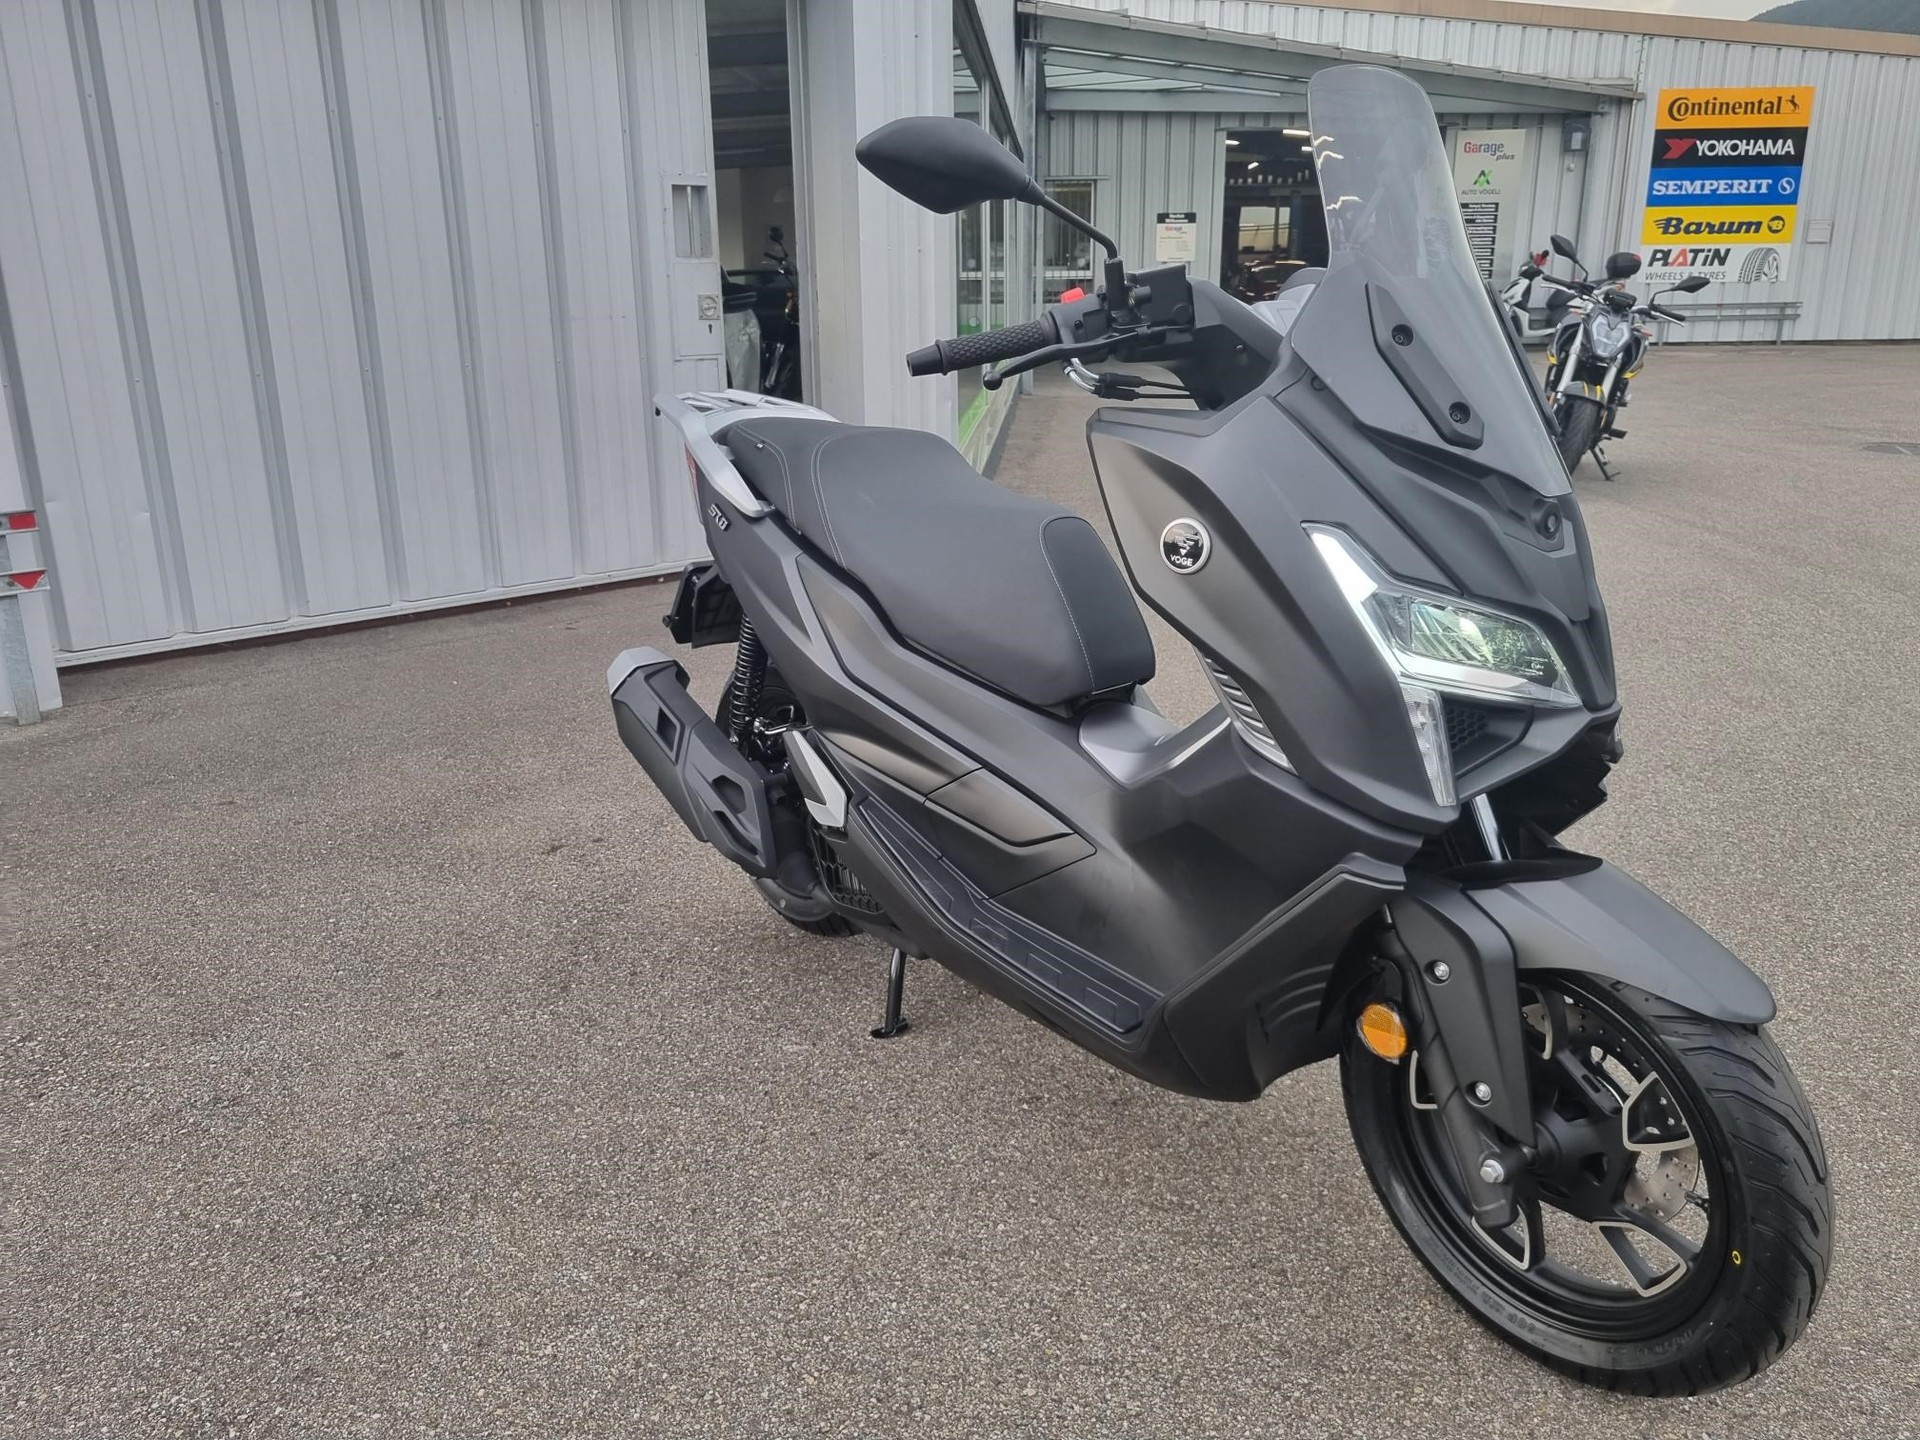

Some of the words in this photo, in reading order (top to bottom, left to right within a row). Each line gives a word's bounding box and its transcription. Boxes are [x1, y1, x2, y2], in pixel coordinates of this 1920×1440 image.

[1667, 96, 1783, 121] Continental
[1463, 141, 1504, 156] Garage
[1695, 138, 1795, 156] YOKOHAMA
[1495, 152, 1515, 161] plus
[1652, 179, 1772, 195] SEMPERIT
[1656, 217, 1763, 235] Barum
[1644, 271, 1684, 281] WHEELS
[1170, 554, 1194, 566] VOGE
